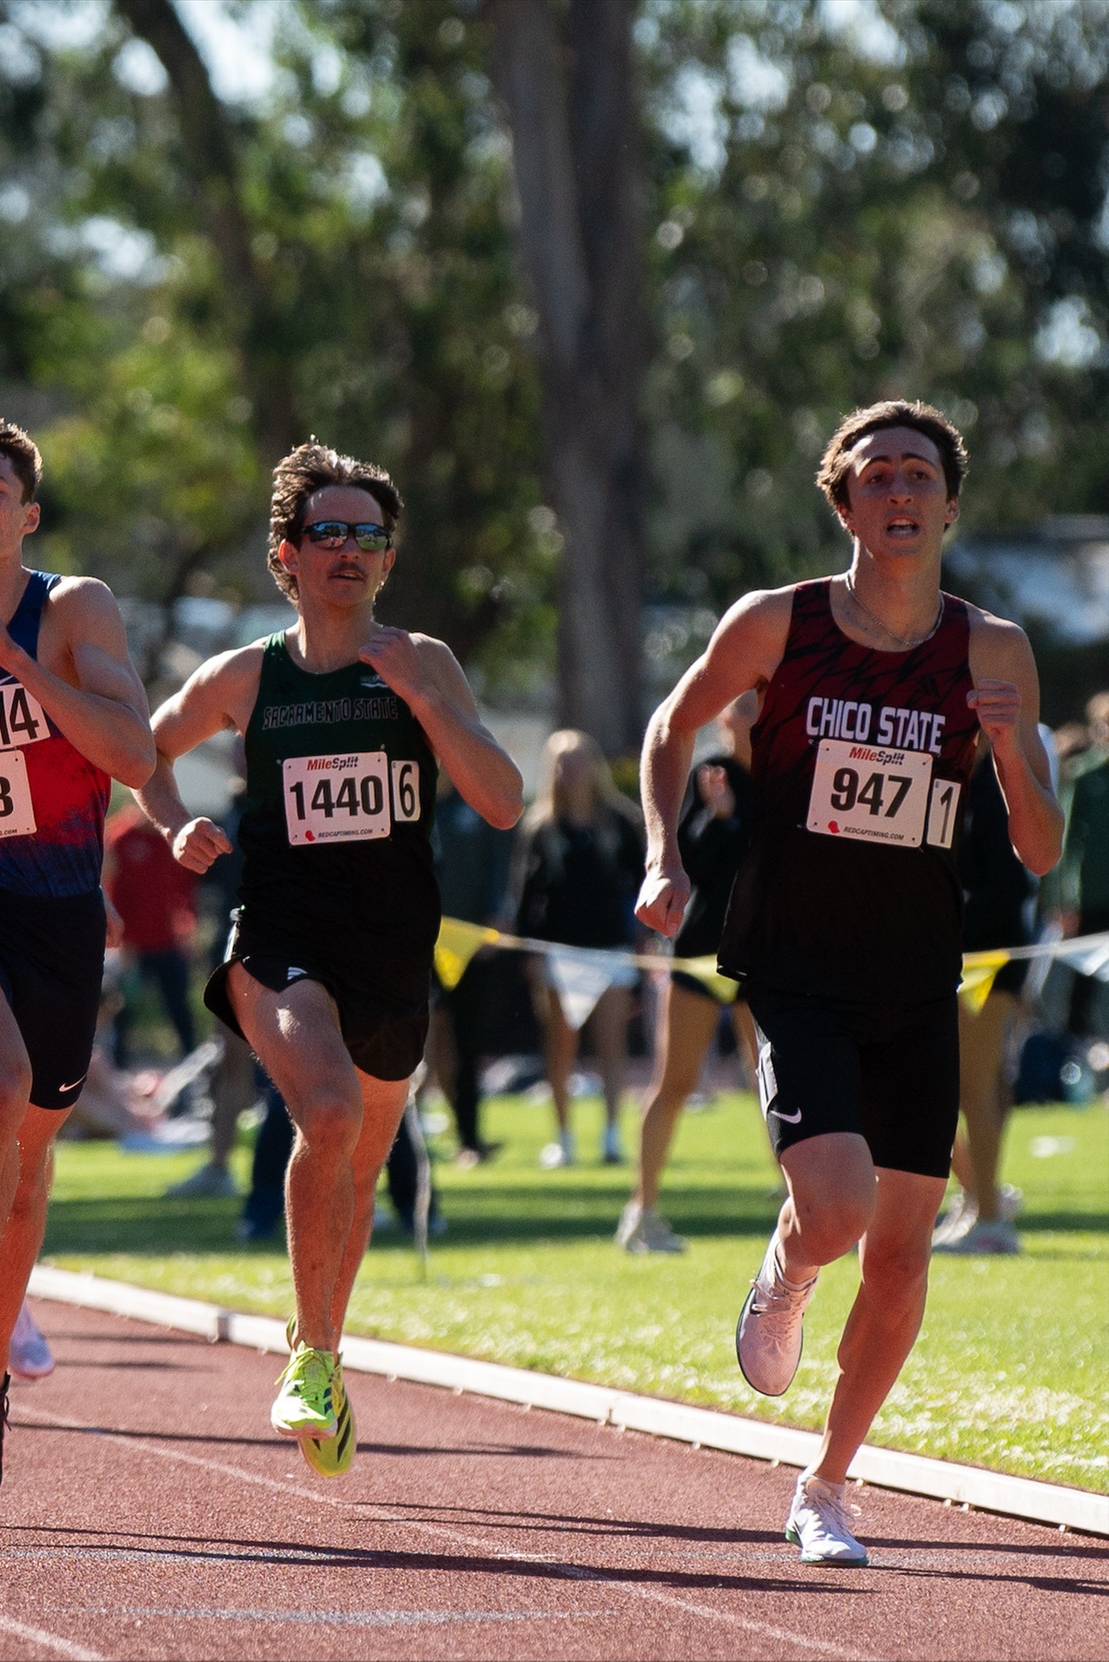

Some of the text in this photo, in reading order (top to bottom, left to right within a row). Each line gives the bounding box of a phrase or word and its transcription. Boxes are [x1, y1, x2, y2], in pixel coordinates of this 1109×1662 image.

[262, 696, 399, 730] SACRAMENTO STATE
[806, 696, 946, 753] CHICO STATE
[307, 756, 359, 772] MileSplit
[849, 746, 905, 766] MileSplit
[289, 775, 384, 821] 1440
[399, 764, 415, 818] 6
[830, 767, 913, 818] 947
[843, 826, 905, 841] REDCAPTIMING.COM
[940, 786, 954, 844] 1
